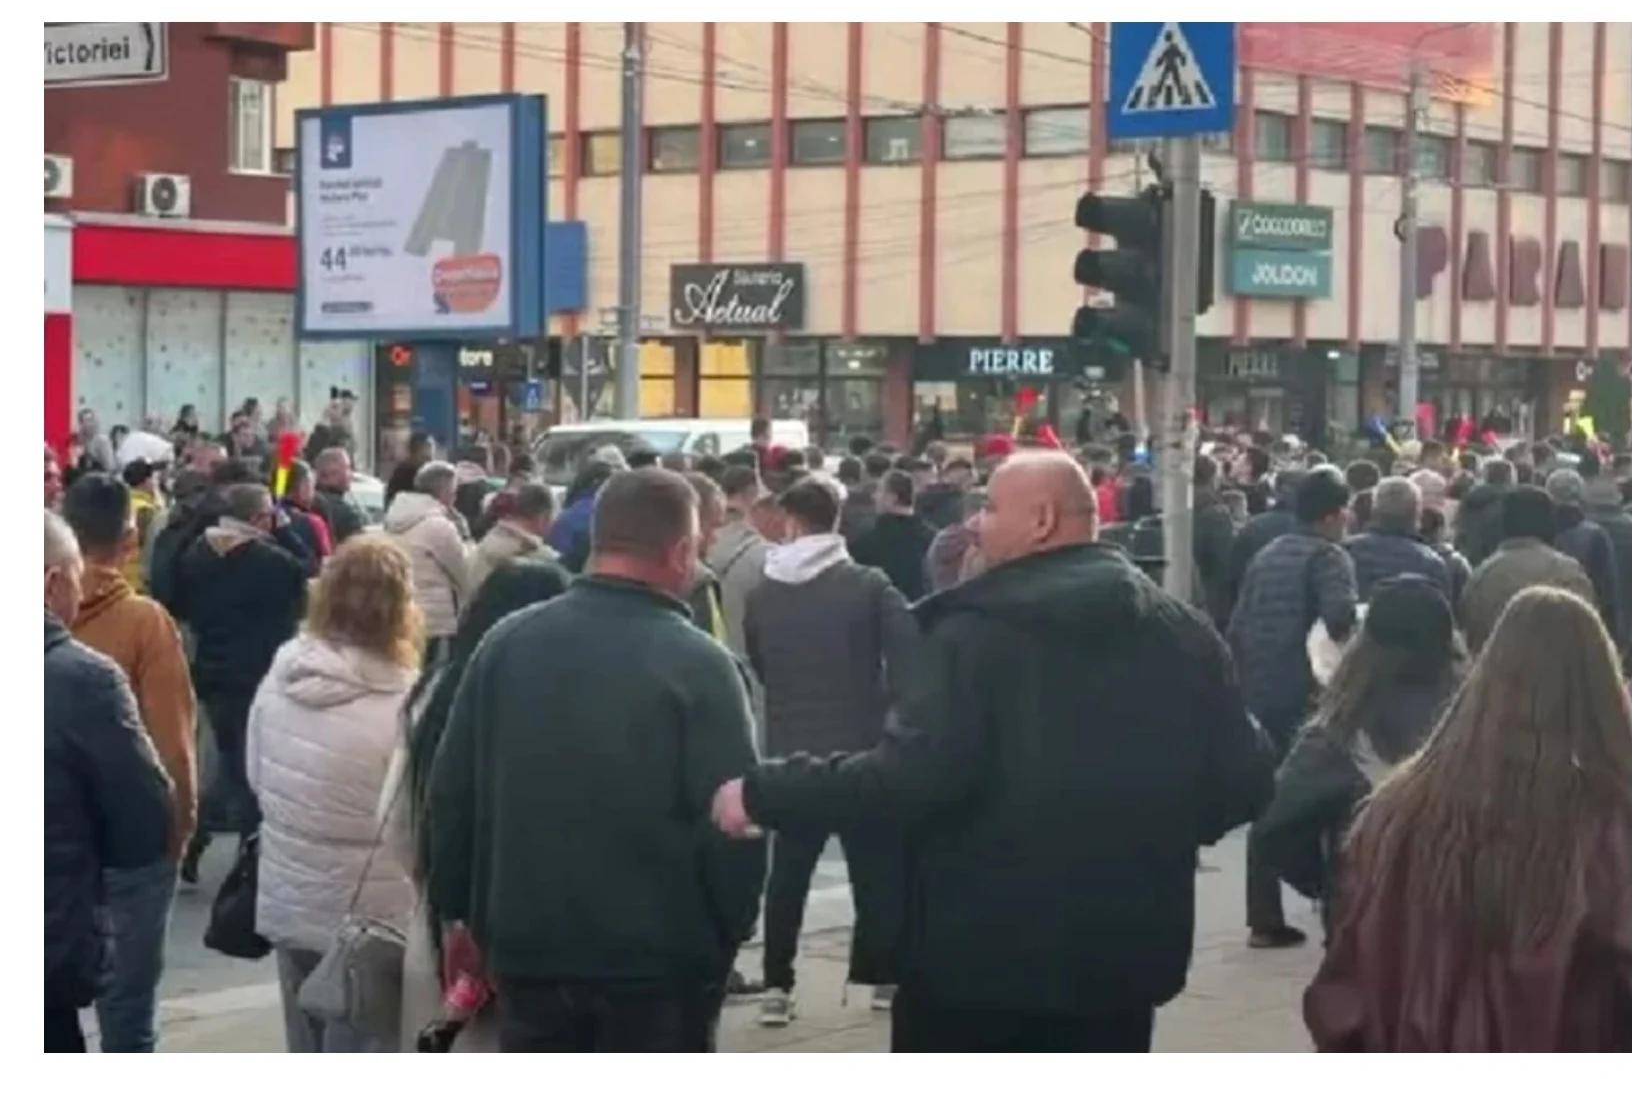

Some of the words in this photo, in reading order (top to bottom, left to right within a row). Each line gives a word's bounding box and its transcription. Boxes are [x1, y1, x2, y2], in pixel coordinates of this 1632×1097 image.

[320, 246, 347, 272] 44
[1252, 263, 1318, 286] JOLIDON
[674, 269, 795, 324] Actual
[969, 348, 1055, 374] PIERRE
